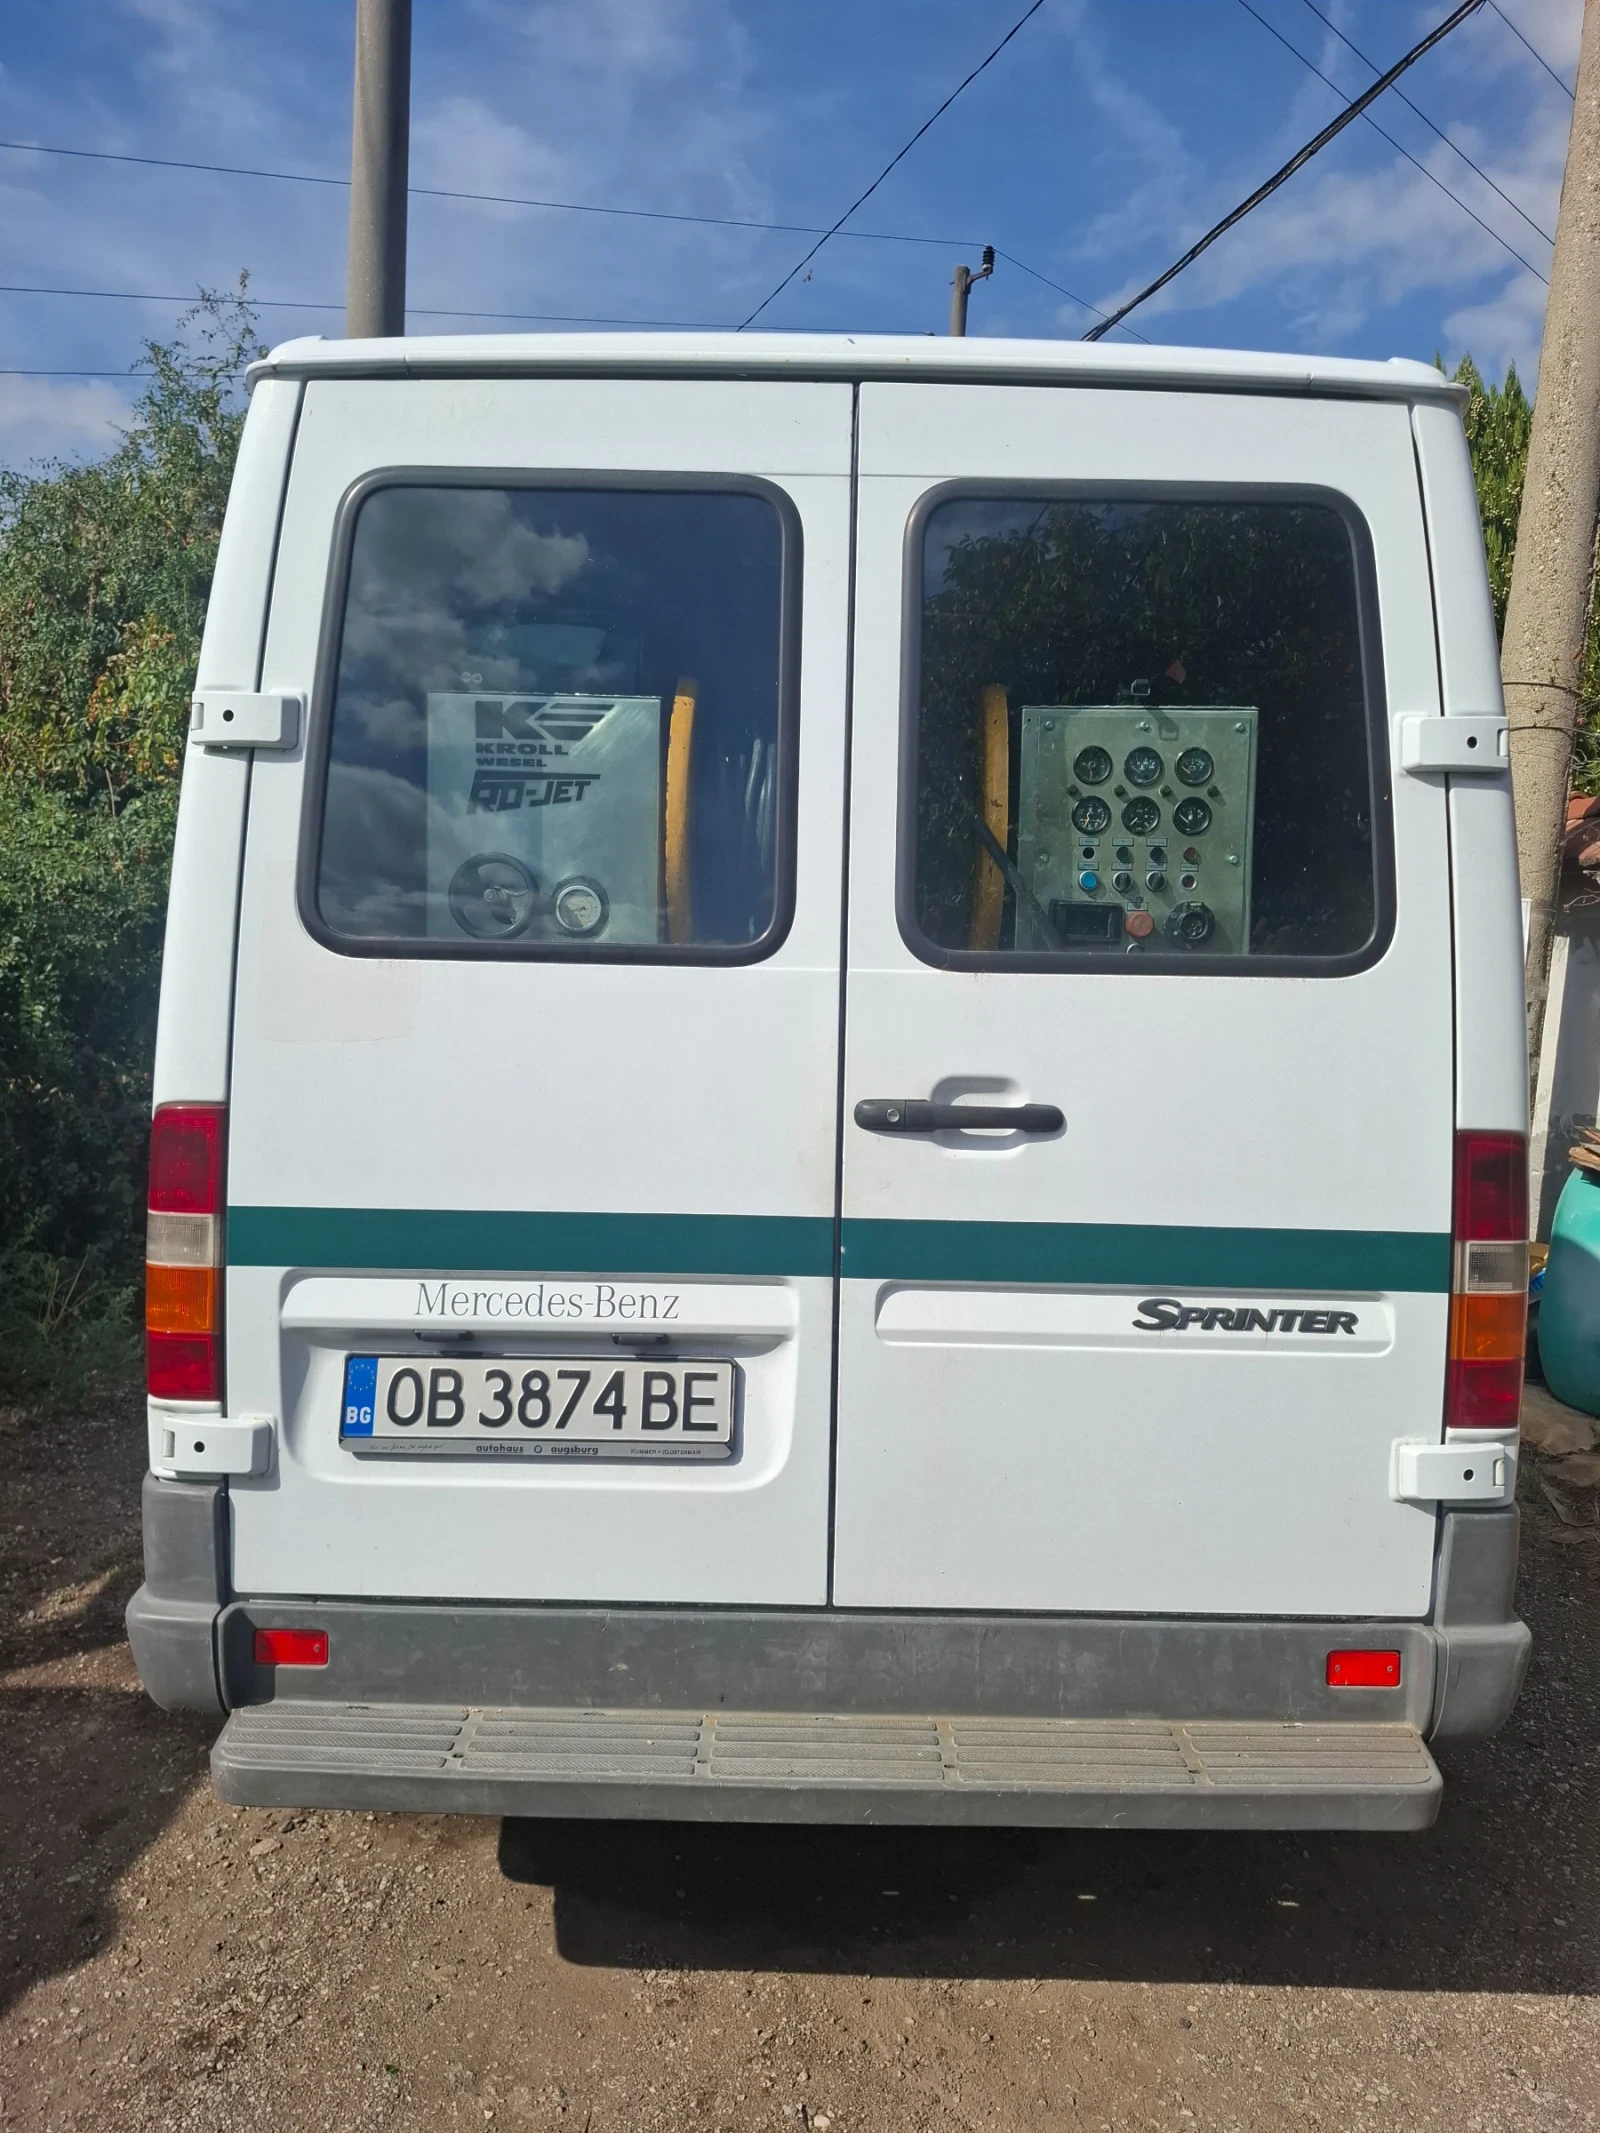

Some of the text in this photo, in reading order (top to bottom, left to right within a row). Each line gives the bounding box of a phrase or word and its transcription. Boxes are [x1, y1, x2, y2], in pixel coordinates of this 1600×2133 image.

[476, 743, 568, 756] KROLL
[476, 758, 547, 768] WESEL
[415, 1283, 679, 1320] Mercedes-Benz
[386, 1367, 719, 1432] OB 3874 BE
[345, 1406, 371, 1424] BG
[476, 1443, 598, 1455] autohaus augsburg
